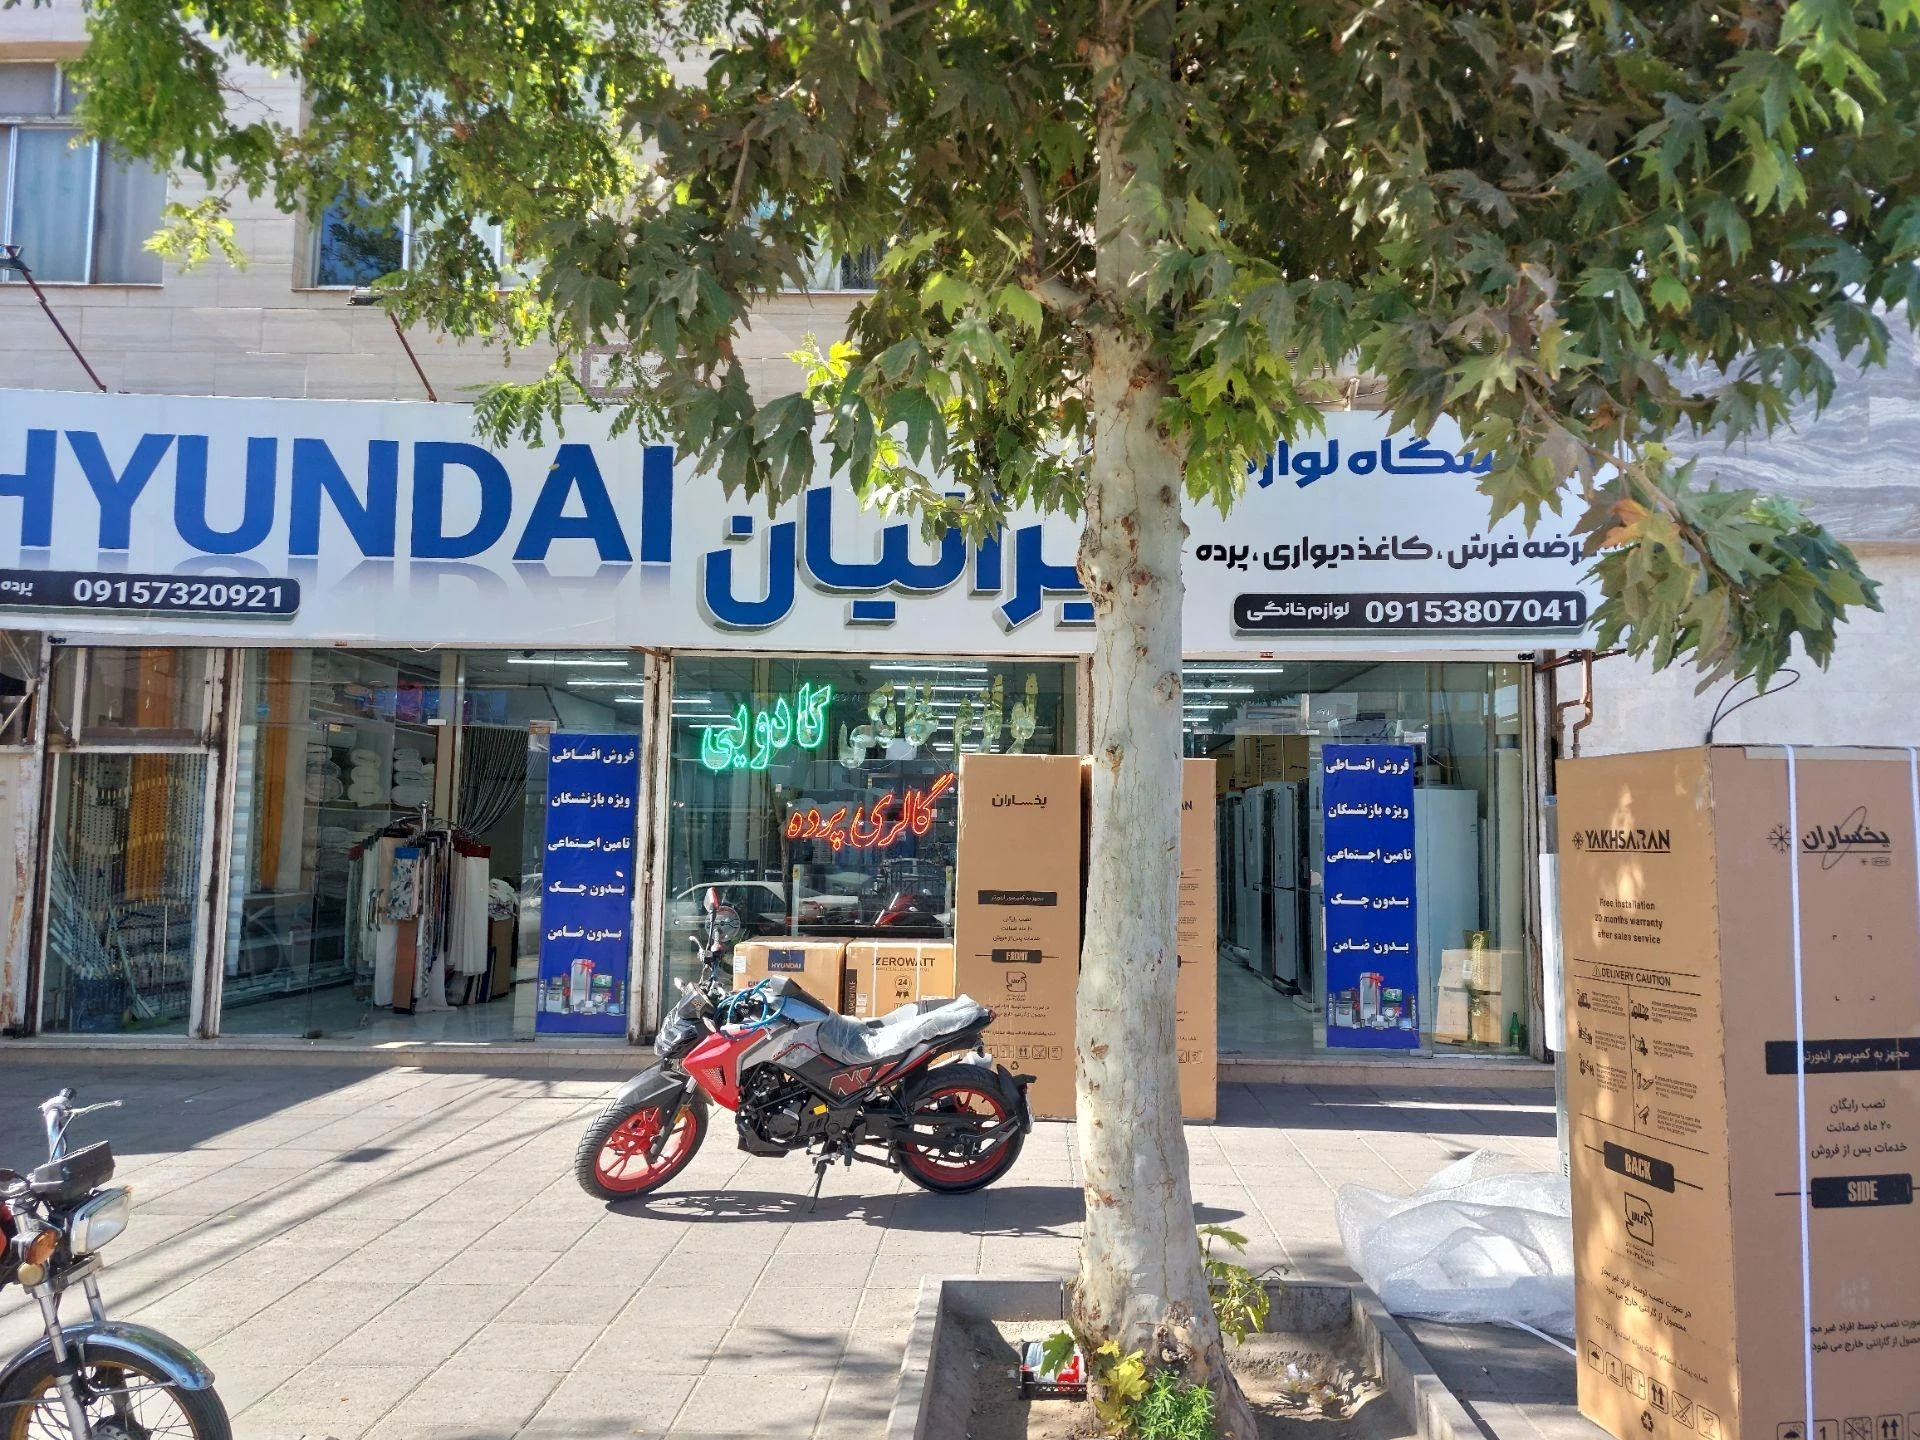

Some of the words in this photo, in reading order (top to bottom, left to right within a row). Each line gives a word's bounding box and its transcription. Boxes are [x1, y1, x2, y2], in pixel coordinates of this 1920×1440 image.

[0, 428, 673, 562] HYUNDAI
[1195, 541, 1250, 571] پرده
[1522, 533, 1597, 567] رضه
[73, 579, 283, 608] 09157320921
[1246, 601, 1306, 621] خانگی
[1366, 599, 1578, 624] 09153807041
[551, 748, 601, 764] اقساطی
[602, 748, 635, 764] فروش
[1325, 758, 1375, 774] اقساطی
[1378, 758, 1410, 774] فروش
[607, 793, 631, 809] ویژه
[849, 772, 956, 849] گالری
[1384, 804, 1410, 820] ویژه
[787, 805, 847, 851] پرده
[547, 836, 601, 852] اجتماعی
[602, 837, 631, 852] تامین
[1585, 829, 1671, 850] YAKHSARAN
[1326, 847, 1381, 863] اجتماعی
[549, 880, 587, 897] چک
[589, 884, 625, 897] بدون
[1330, 892, 1370, 909] چک
[1372, 894, 1410, 910] بدون
[1599, 898, 1614, 908] Free
[1603, 915, 1629, 925] months
[1629, 917, 1664, 930] warranty
[547, 925, 585, 941] ضامن
[586, 926, 623, 941] بدون
[1597, 930, 1613, 940] after
[1614, 931, 1632, 942] sales
[1633, 934, 1661, 944] service
[1332, 938, 1371, 954] ضامن
[1373, 940, 1410, 955] بدون
[872, 957, 936, 967] ZEROWATT
[1005, 951, 1029, 961] FRONT
[897, 978, 908, 986] 24
[1601, 969, 1635, 982] DELIVERY
[1636, 973, 1671, 988] CAUTION
[1829, 1097, 1858, 1114] رایگان
[1861, 1098, 1887, 1111] نصب
[1826, 1121, 1860, 1133] ضمانت
[1863, 1121, 1878, 1131] ماه
[1811, 1143, 1840, 1159] فروش
[1842, 1143, 1850, 1157] از
[1852, 1145, 1872, 1157] پس
[1874, 1142, 1908, 1153] خدمات
[1624, 1153, 1652, 1181] BACK
[1847, 1180, 1879, 1202] SIDE
